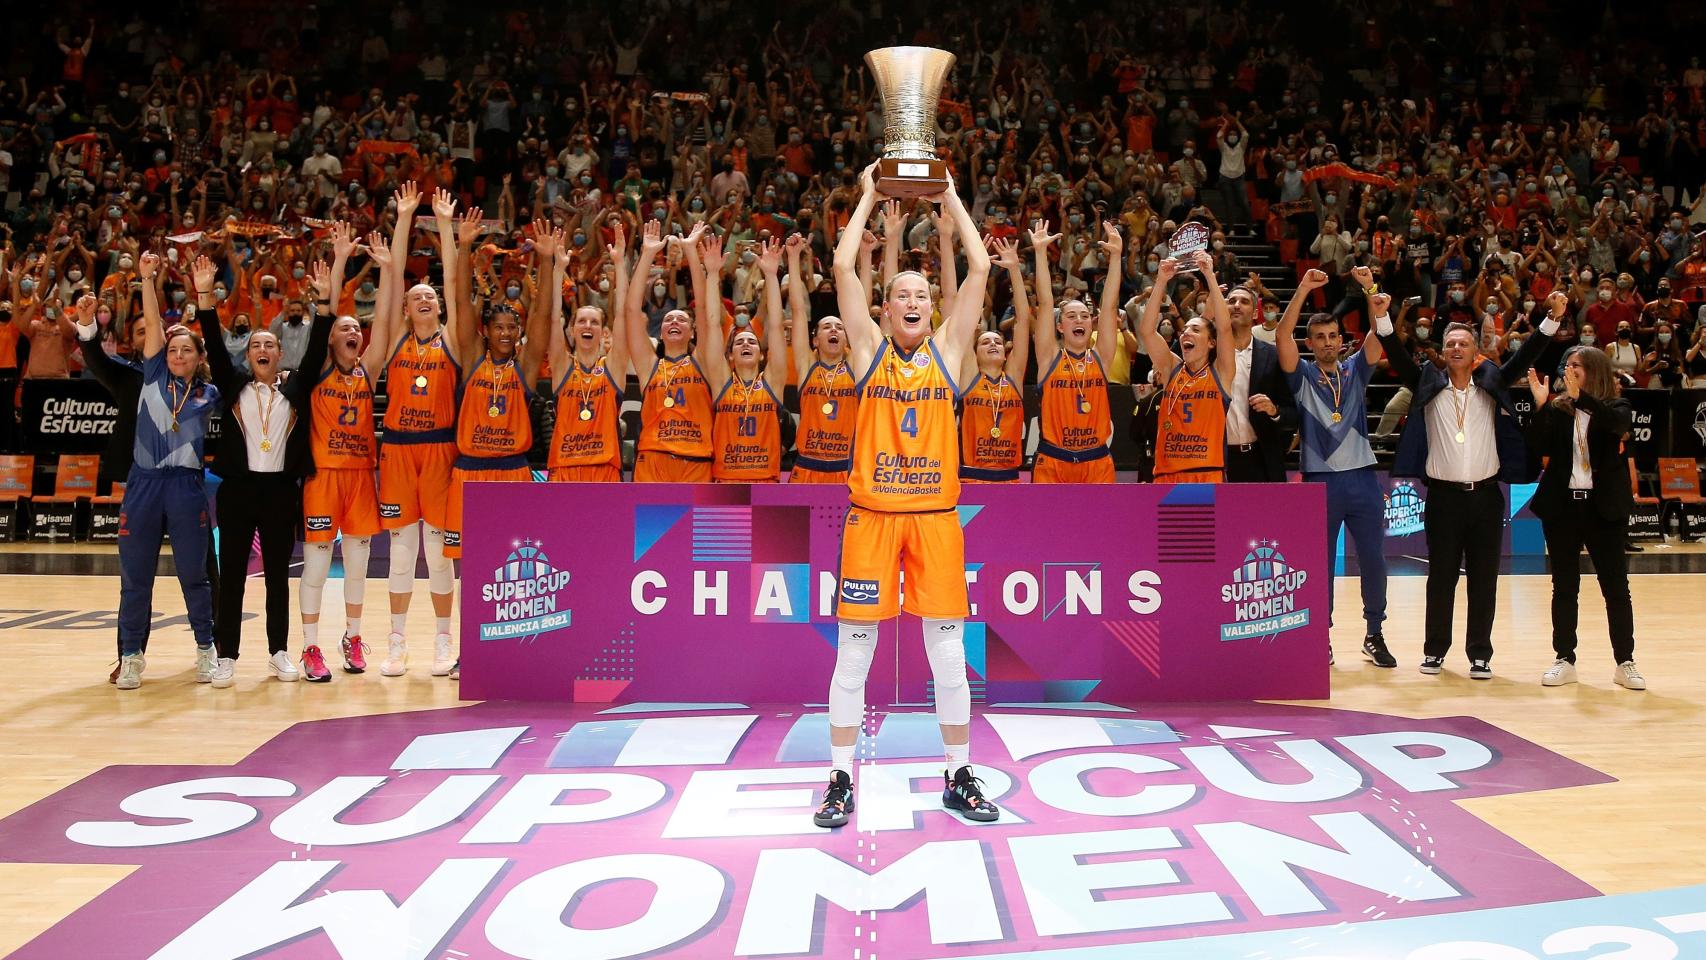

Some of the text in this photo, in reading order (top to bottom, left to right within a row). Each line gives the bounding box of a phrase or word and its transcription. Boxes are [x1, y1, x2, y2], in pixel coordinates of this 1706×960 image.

[866, 385, 950, 402] VALENCIA BC
[43, 398, 119, 416] Cultura de
[1183, 403, 1193, 423] 5
[900, 407, 919, 438] 4
[1637, 414, 1652, 424] del
[471, 434, 516, 447] Esfuerzo
[657, 428, 702, 439] Esfuerzo
[807, 428, 842, 441] Cultura
[1166, 432, 1200, 443] Cultura
[561, 441, 604, 453] Esfuerzo
[725, 443, 760, 454] Cultura
[804, 439, 849, 452] Esfuerzo
[1164, 442, 1208, 453] Esfuerzo
[723, 453, 769, 464] Esfuerzo
[875, 452, 941, 468] Cultura del
[872, 467, 942, 484] Esfuerzo
[871, 485, 942, 495] @ValenciaBasket
[47, 514, 73, 524] isaval
[1388, 514, 1420, 529] WOMEN
[1635, 514, 1660, 524] isaval
[482, 570, 571, 602] SUPERCUP
[843, 580, 878, 591] PULEVA
[1221, 570, 1307, 602] SUPERCUP
[495, 594, 556, 621] WOMEN
[1235, 593, 1294, 621] WOMEN
[483, 613, 569, 637] VALENCIA 2021
[1223, 612, 1307, 637] VALENCIA 2021
[66, 731, 1495, 847] SUPERCUP
[146, 811, 1463, 960] WOMEN
